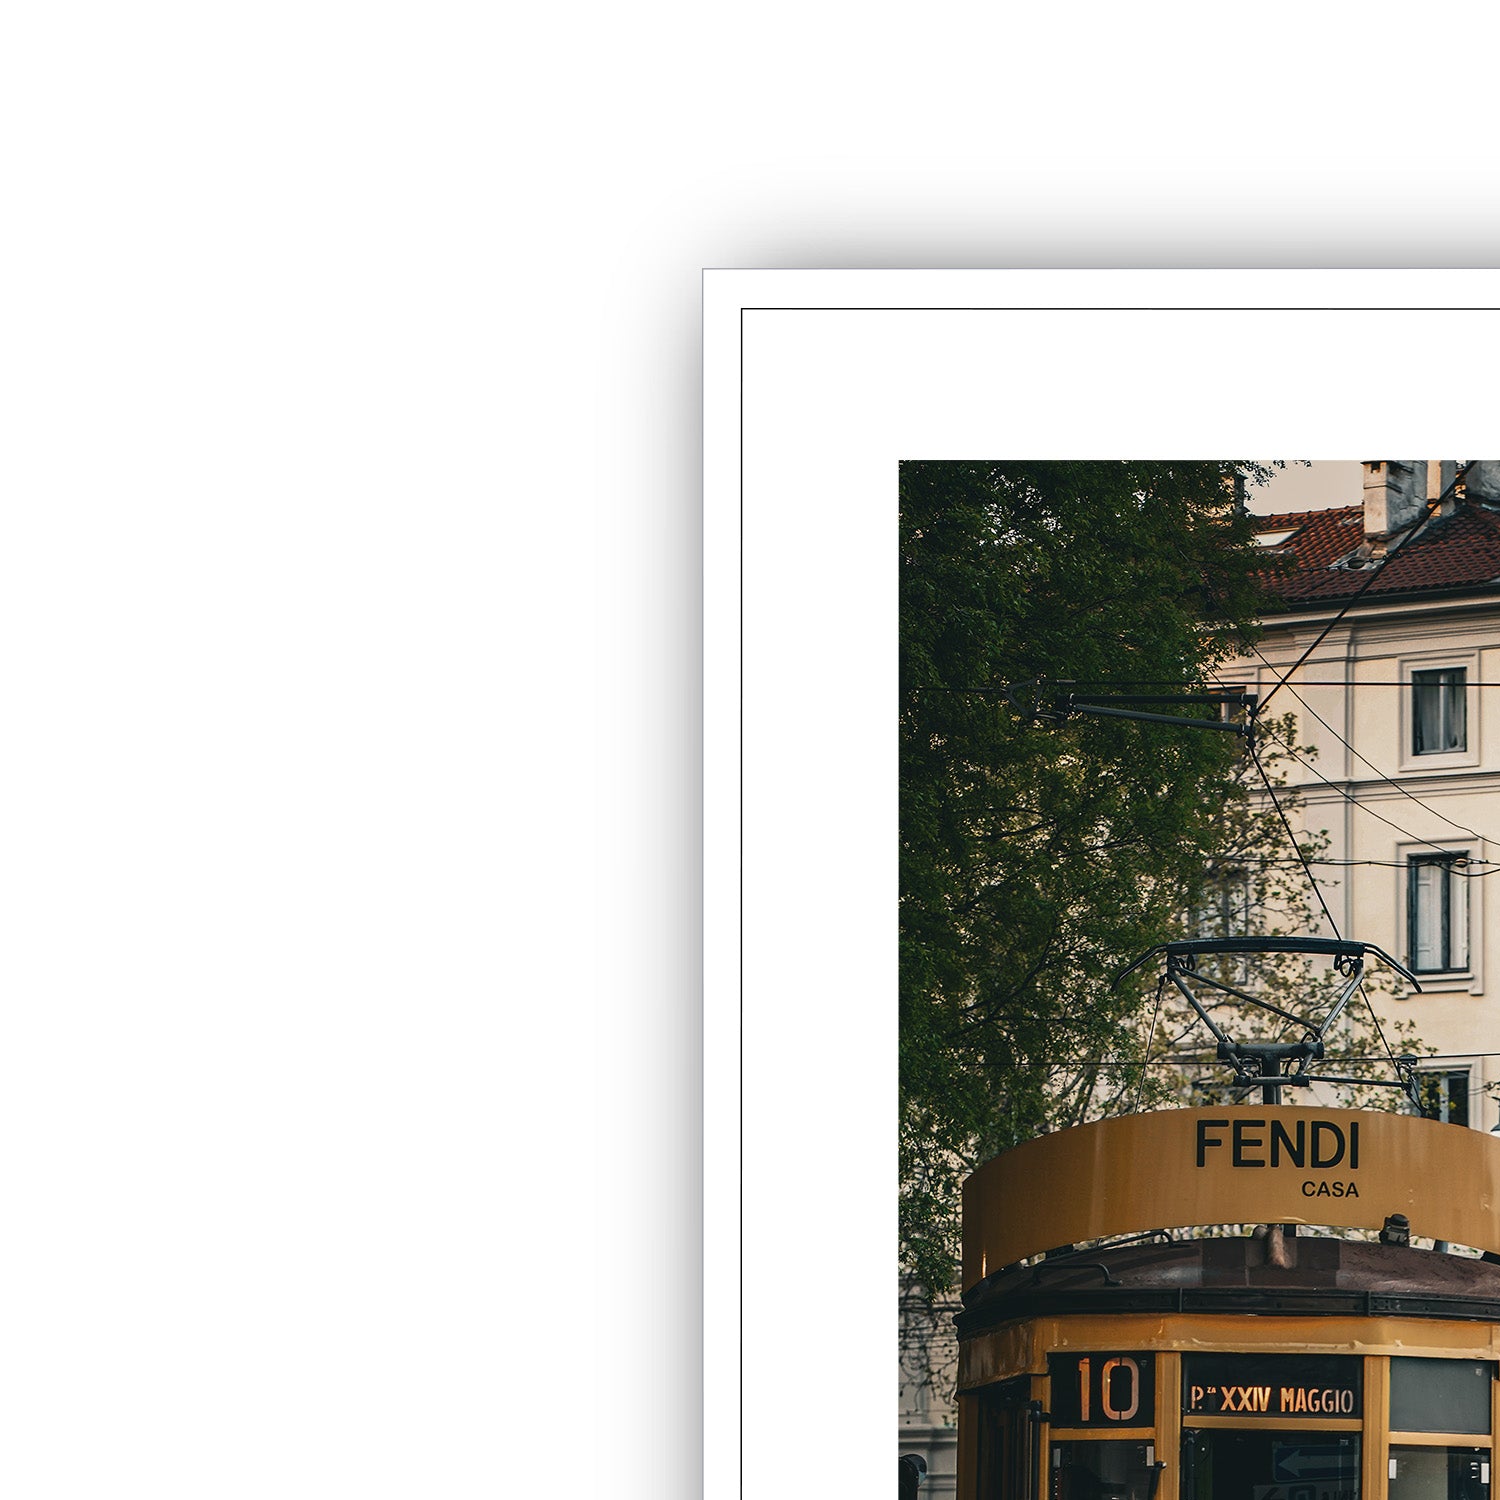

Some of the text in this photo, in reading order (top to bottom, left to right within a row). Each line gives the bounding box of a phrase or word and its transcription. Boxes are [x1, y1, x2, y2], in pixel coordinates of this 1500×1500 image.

[1196, 1119, 1359, 1169] FENDI
[1301, 1180, 1359, 1198] CASA
[1079, 1358, 1139, 1421] 10
[1220, 1386, 1271, 1412] XXIV
[1281, 1387, 1354, 1413] MAGGIO
